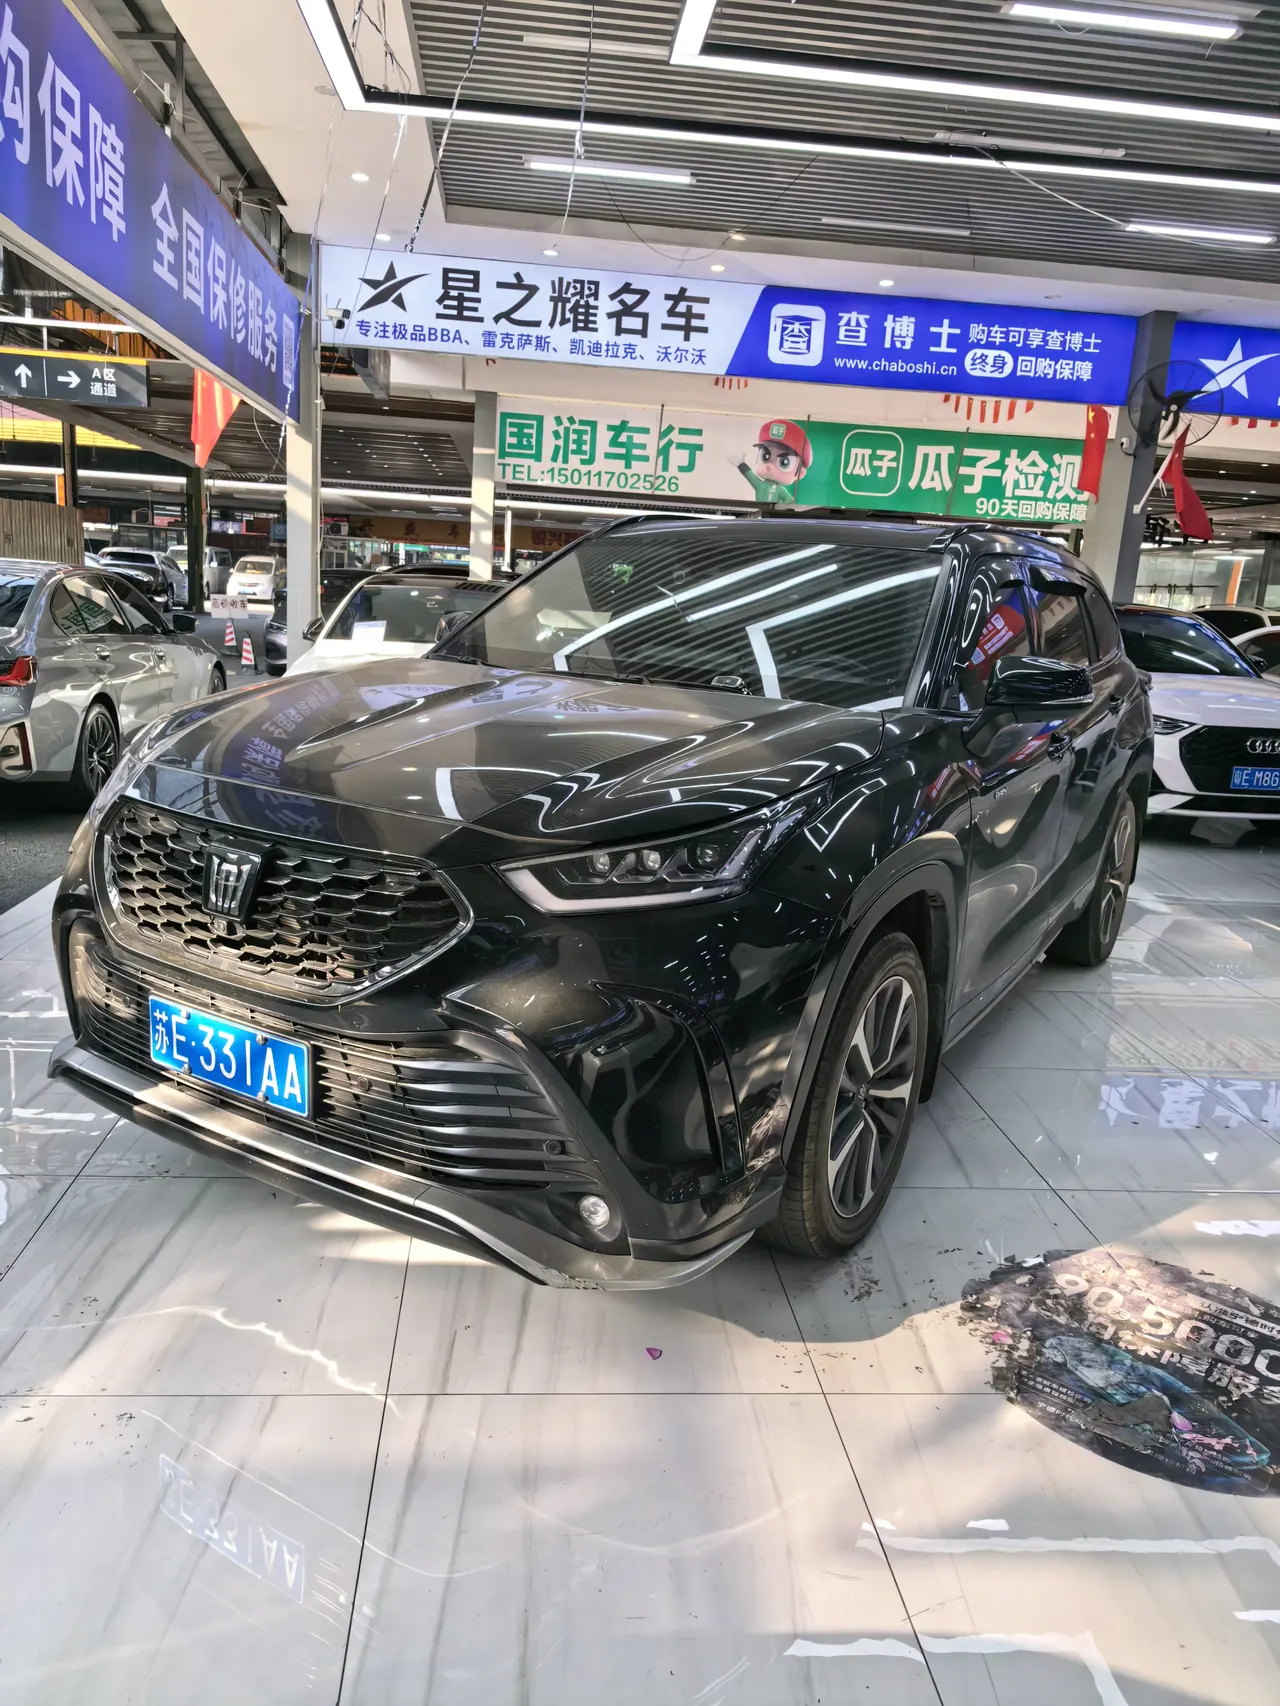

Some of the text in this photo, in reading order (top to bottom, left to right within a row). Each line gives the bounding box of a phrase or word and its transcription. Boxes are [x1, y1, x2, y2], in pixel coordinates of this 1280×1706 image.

[151, 182, 278, 372] 全国保修服务
[435, 267, 710, 342] 星之耀名车
[355, 319, 707, 365] 专注极品BBA、雷克萨斯、凯迪拉克、沃尔沃
[835, 311, 961, 353] 查博士
[968, 323, 1102, 353] 购车可享查博士
[834, 356, 957, 376] www.chaboshi.cn
[969, 352, 1093, 381] 终身 回购保障
[90, 382, 117, 397] 通道
[497, 411, 704, 473] 国润车行
[497, 462, 680, 493] TEL:15011702526
[845, 447, 898, 478] 瓜子
[976, 498, 1088, 522] 90天回购保障
